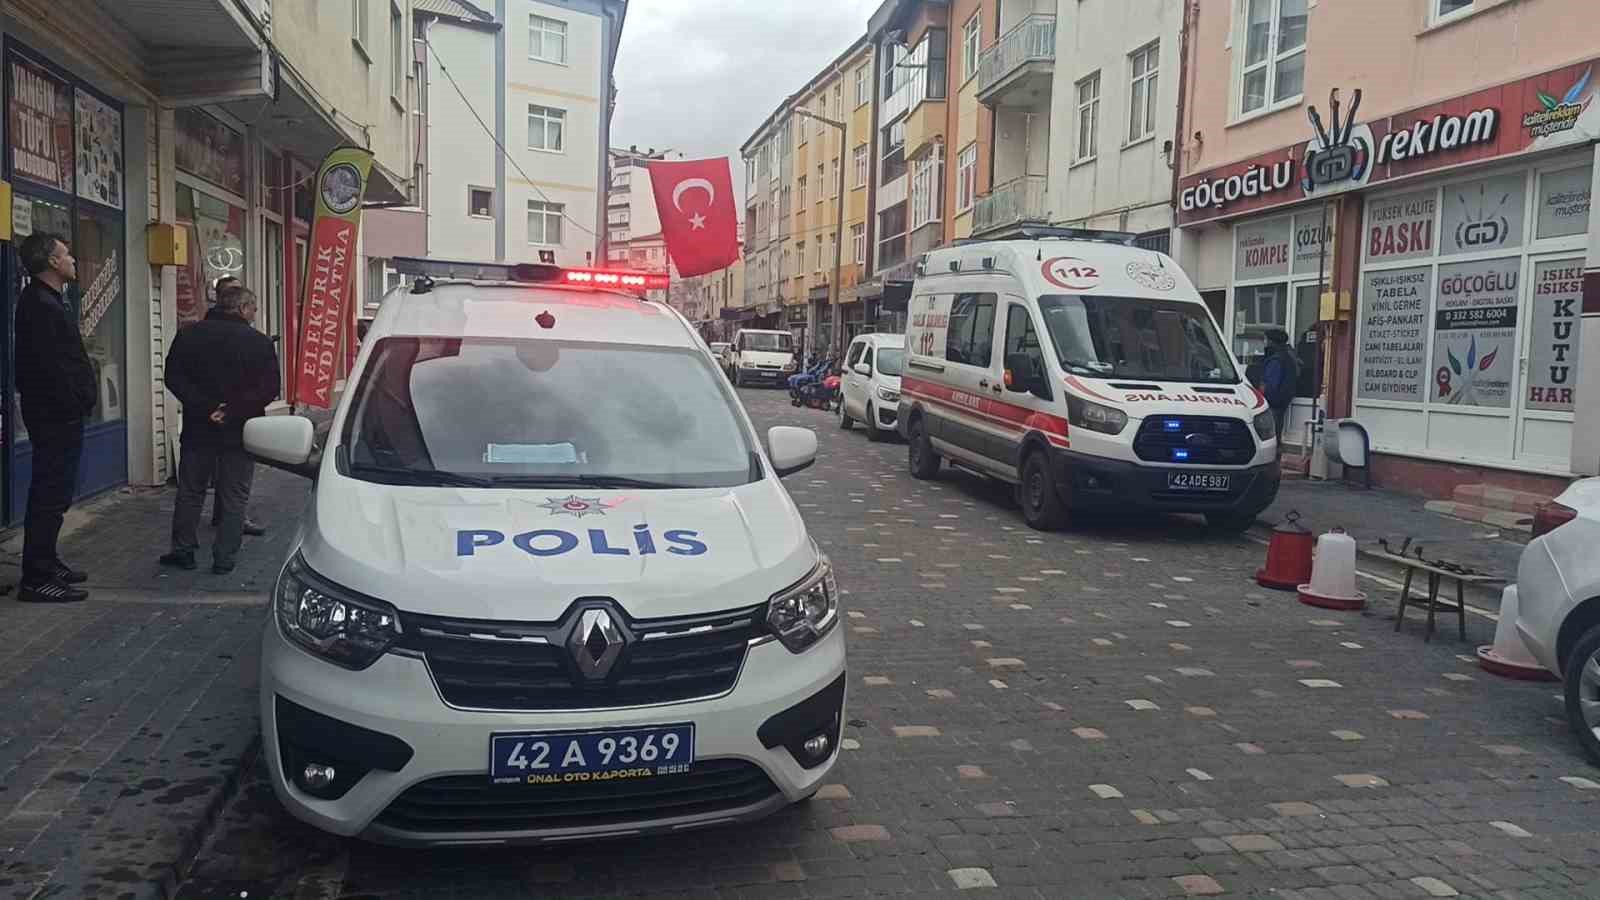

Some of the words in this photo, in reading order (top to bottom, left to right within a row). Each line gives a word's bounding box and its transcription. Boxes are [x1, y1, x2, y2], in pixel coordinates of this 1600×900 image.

[1180, 159, 1293, 211] GÖÇOĞLU
[1376, 107, 1496, 164] reklam
[1370, 220, 1432, 257] BASKI
[1246, 243, 1288, 268] KOMPLE
[1055, 266, 1099, 279] 112
[1441, 270, 1517, 297] GÖÇOĞLU
[1376, 286, 1417, 298] TABELA
[315, 227, 350, 401] AYDINLATMA
[1364, 382, 1380, 392] CAM
[457, 523, 708, 558] POLİS
[507, 741, 551, 770] 42
[560, 739, 587, 768] A
[598, 732, 680, 766] 9369
[563, 771, 590, 782] OTO
[592, 767, 653, 780] KAPORTA
